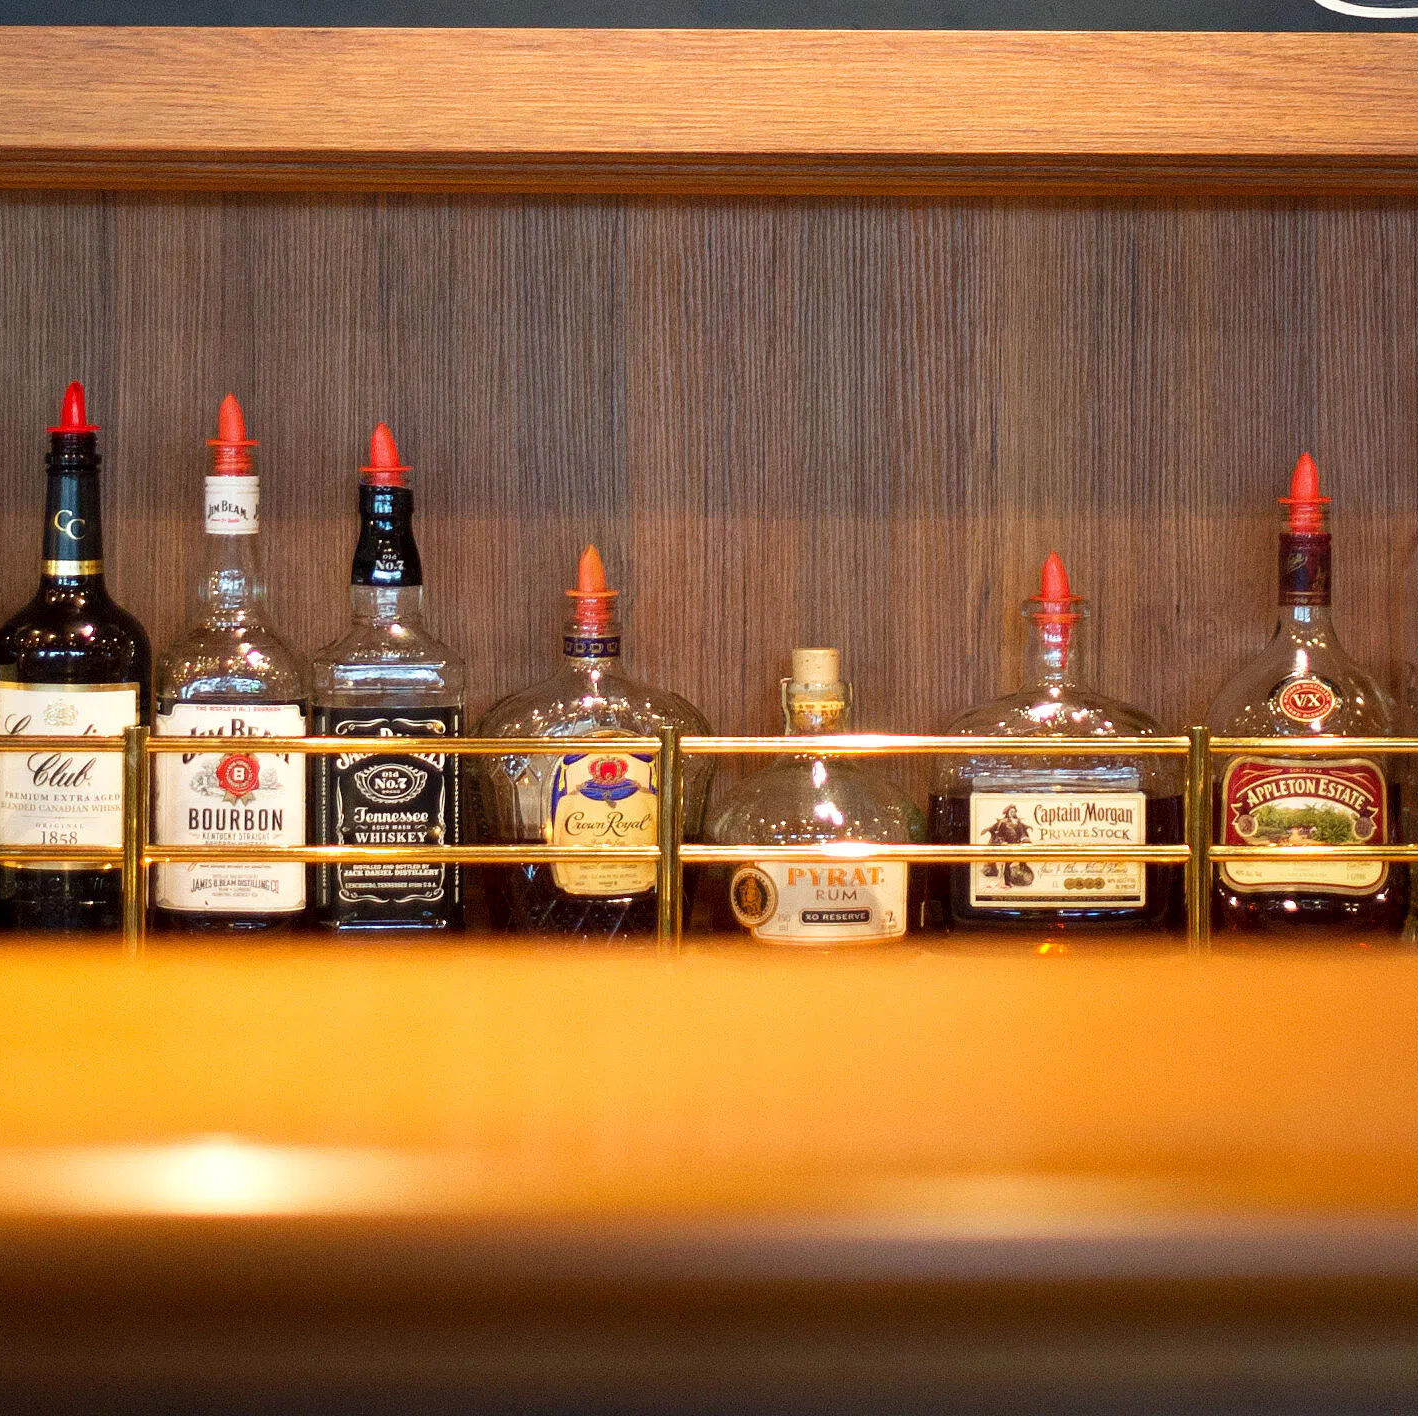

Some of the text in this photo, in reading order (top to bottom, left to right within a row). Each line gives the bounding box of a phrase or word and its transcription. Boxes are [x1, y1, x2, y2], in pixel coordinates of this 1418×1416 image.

[374, 777, 408, 790] No.7
[5, 791, 49, 801] PREMIUM
[53, 792, 90, 802] EXTRA
[1246, 778, 1367, 811] APPLETON ESTATE
[188, 807, 283, 832] BOURBON
[354, 806, 429, 824] Tennessee
[1034, 802, 1133, 826] Captain Morgan
[565, 811, 651, 837] Crown Royal
[40, 830, 78, 845] 1858
[355, 831, 428, 843] WHISKEY
[1038, 827, 1132, 840] PRIVATE STOCK
[816, 889, 857, 901] RUM
[822, 911, 866, 921] RESERVE
